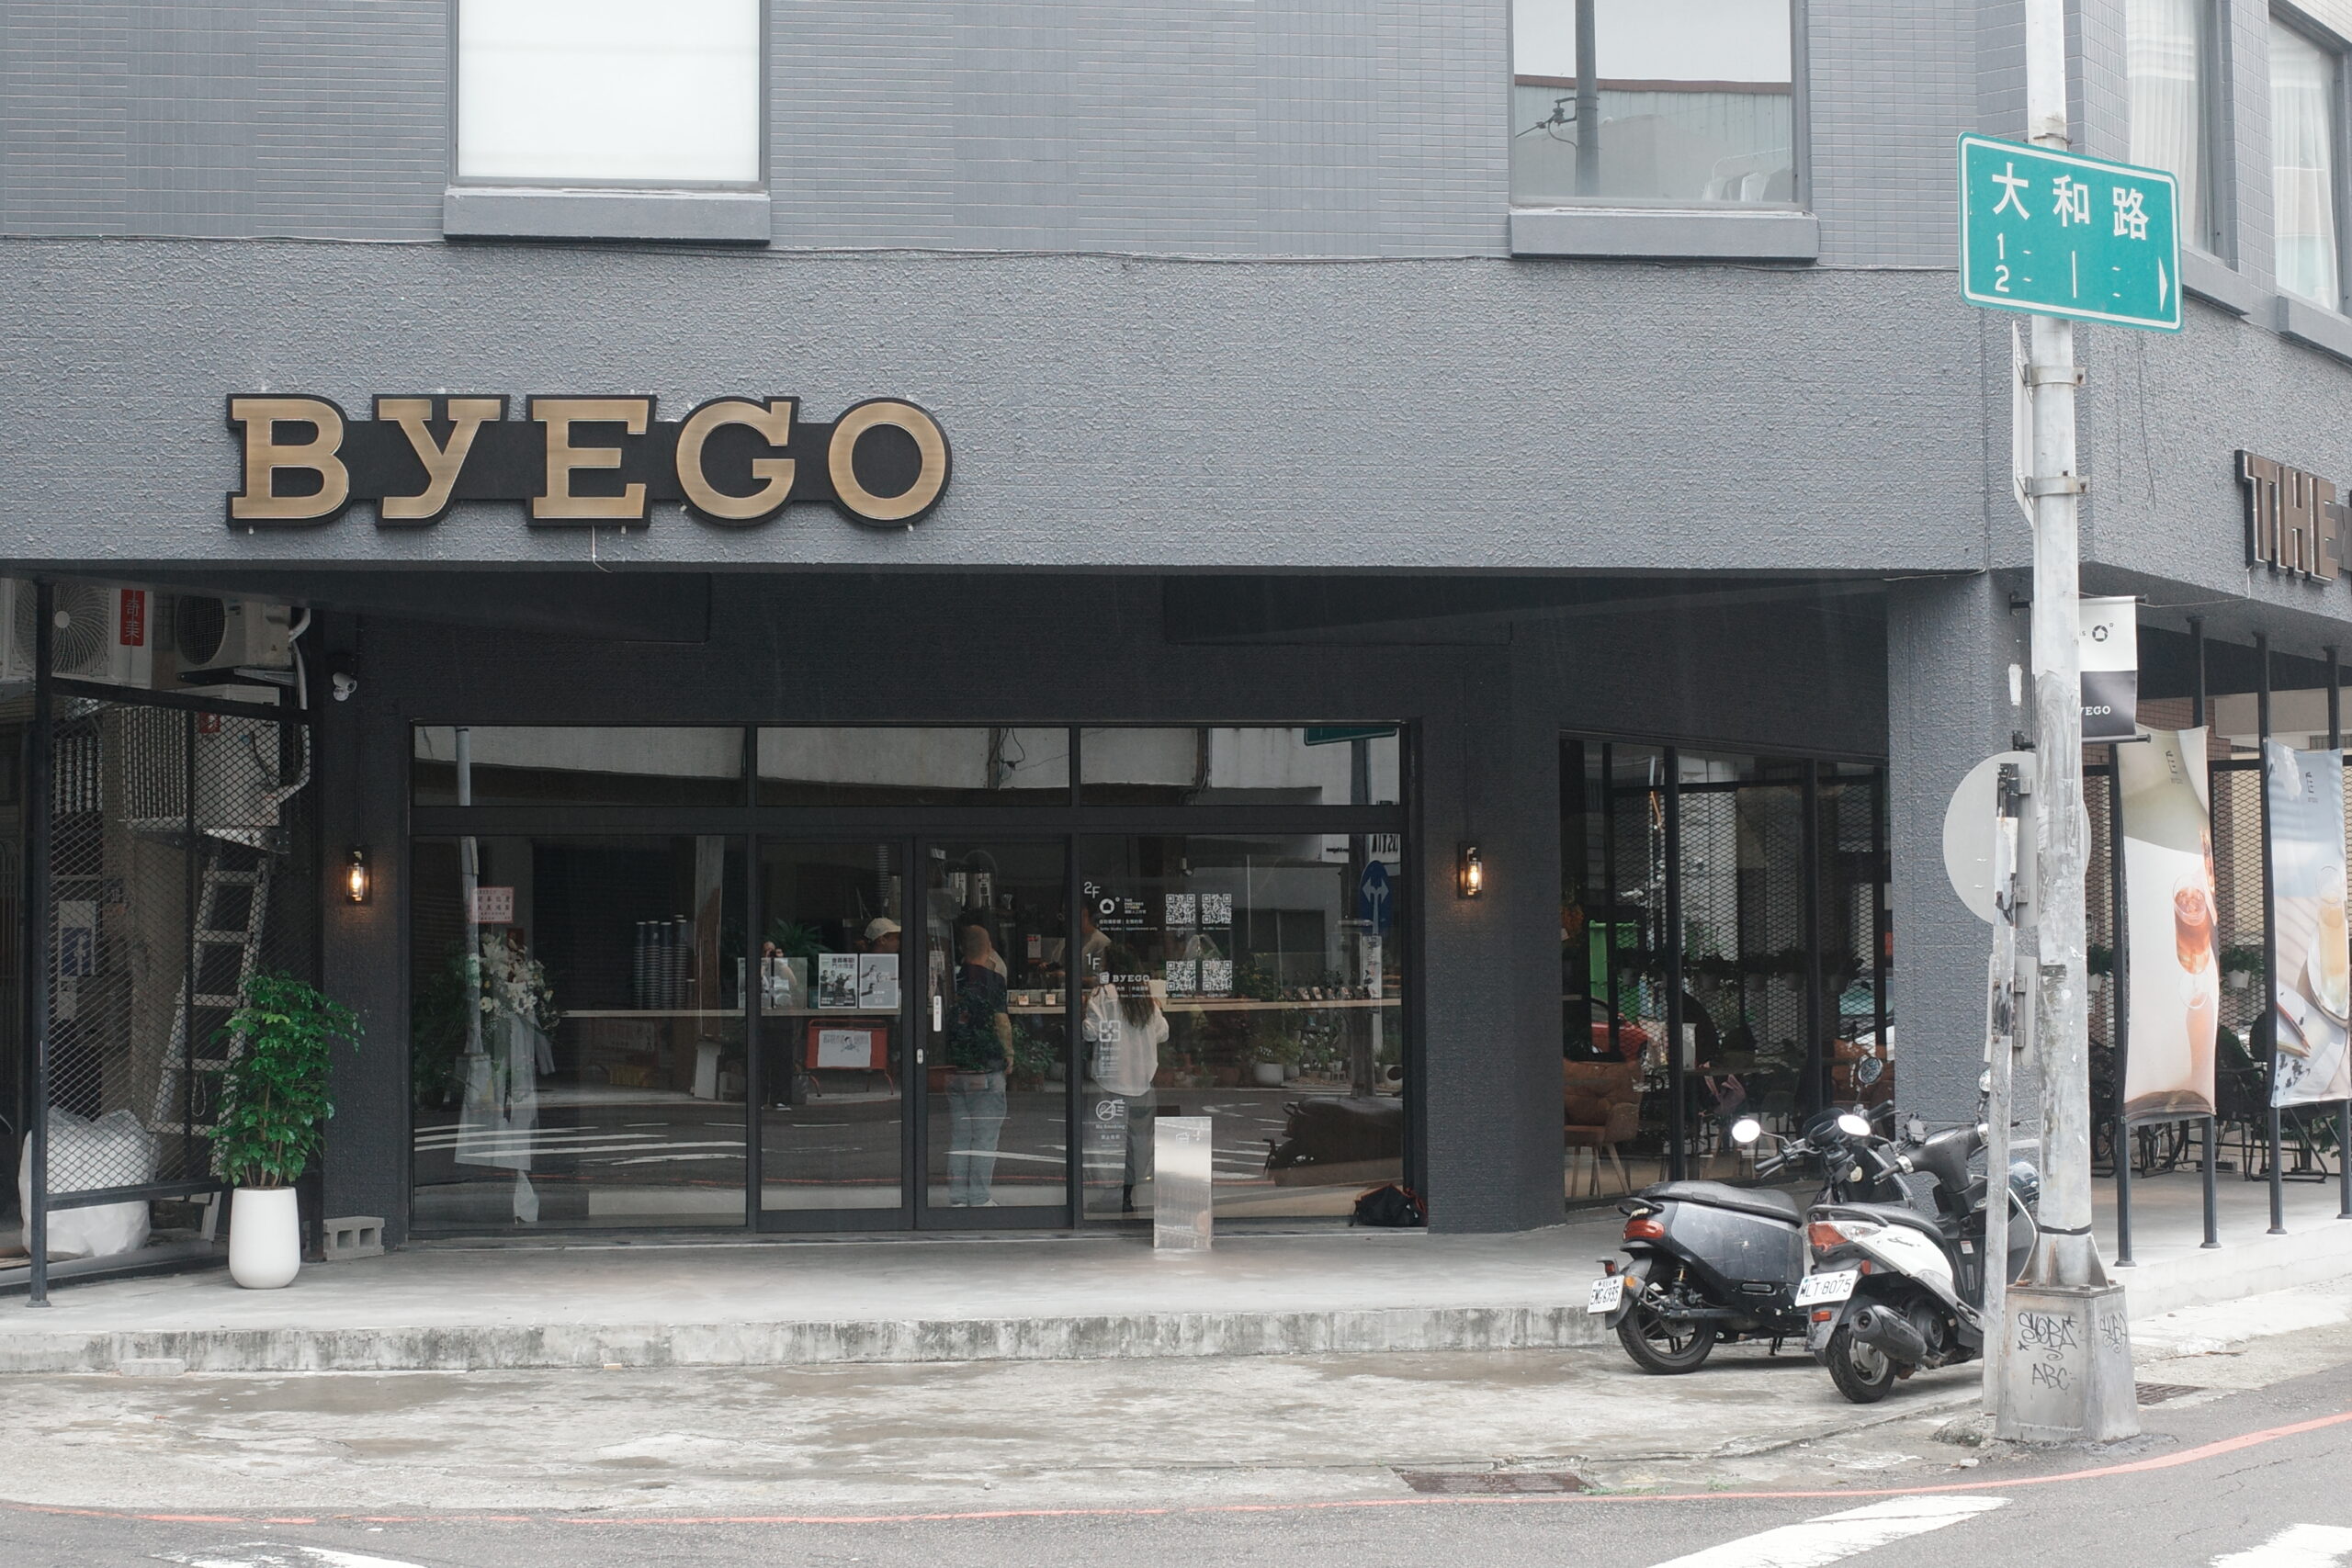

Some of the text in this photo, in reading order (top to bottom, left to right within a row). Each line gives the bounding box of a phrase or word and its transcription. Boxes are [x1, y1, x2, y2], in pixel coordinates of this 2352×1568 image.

[1992, 162, 2149, 241] 大和路
[230, 396, 948, 524] BYEGO
[2236, 450, 2339, 582] THE
[1084, 881, 1101, 899] 2F
[1086, 953, 1101, 971] 1F
[1112, 974, 1150, 983] BYEGO
